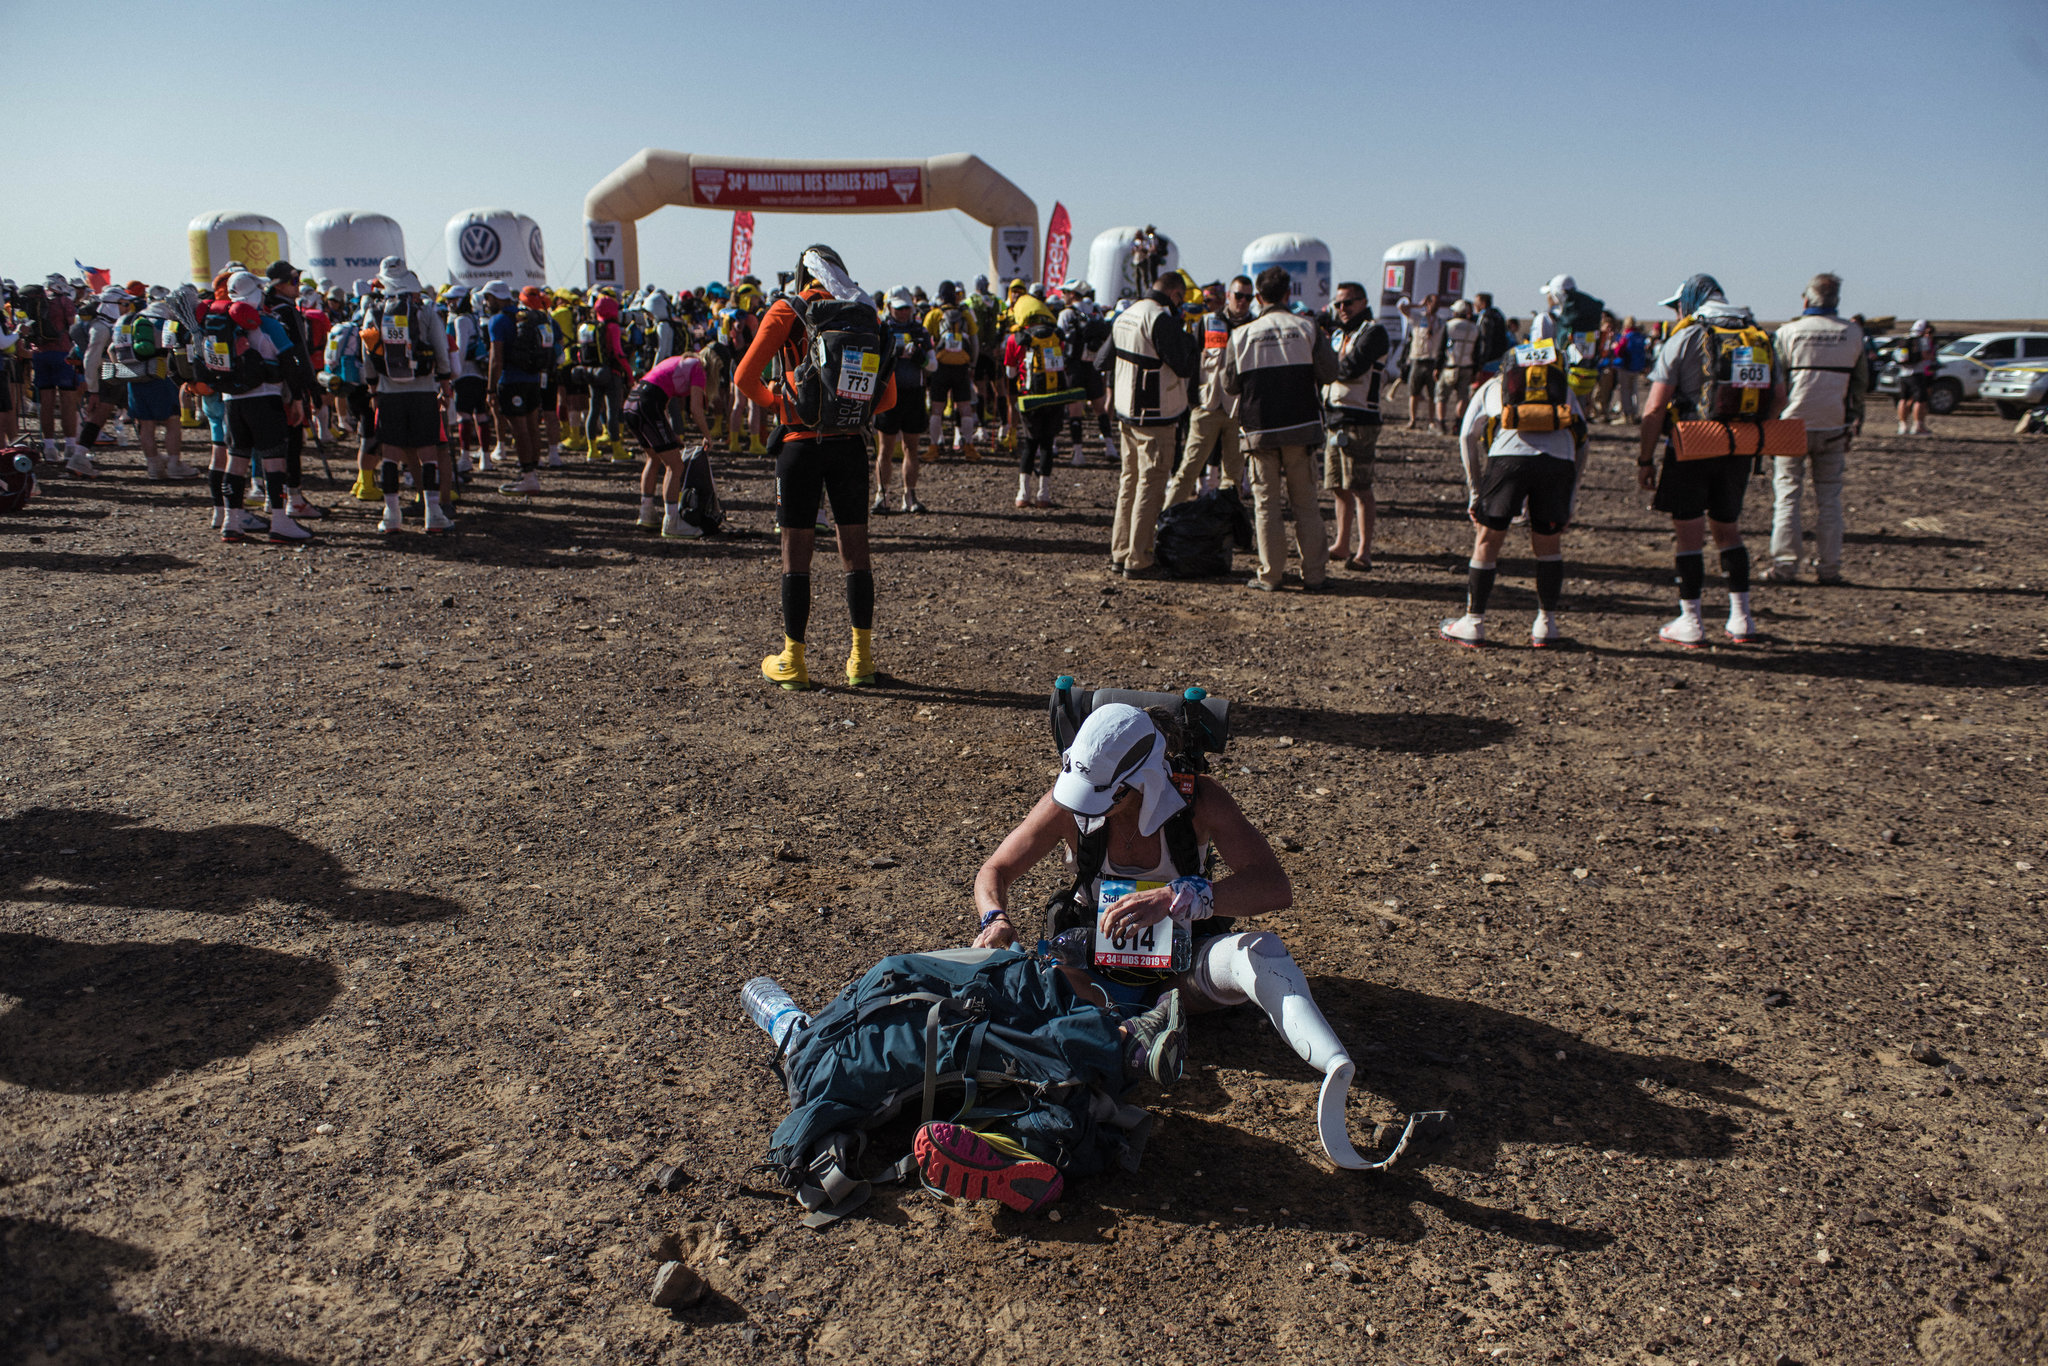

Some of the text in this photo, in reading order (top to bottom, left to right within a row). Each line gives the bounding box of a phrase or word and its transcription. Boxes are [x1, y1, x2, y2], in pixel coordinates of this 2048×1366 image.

[747, 173, 803, 191] MARATHON
[804, 173, 823, 191] DES
[824, 173, 861, 191] SABLES
[863, 171, 888, 190] 2019
[387, 327, 405, 340] 595
[1525, 350, 1549, 361] 452
[1739, 367, 1764, 381] 603
[848, 375, 869, 392] 773
[1122, 955, 1139, 965] MDS
[1140, 956, 1160, 966] 2019
